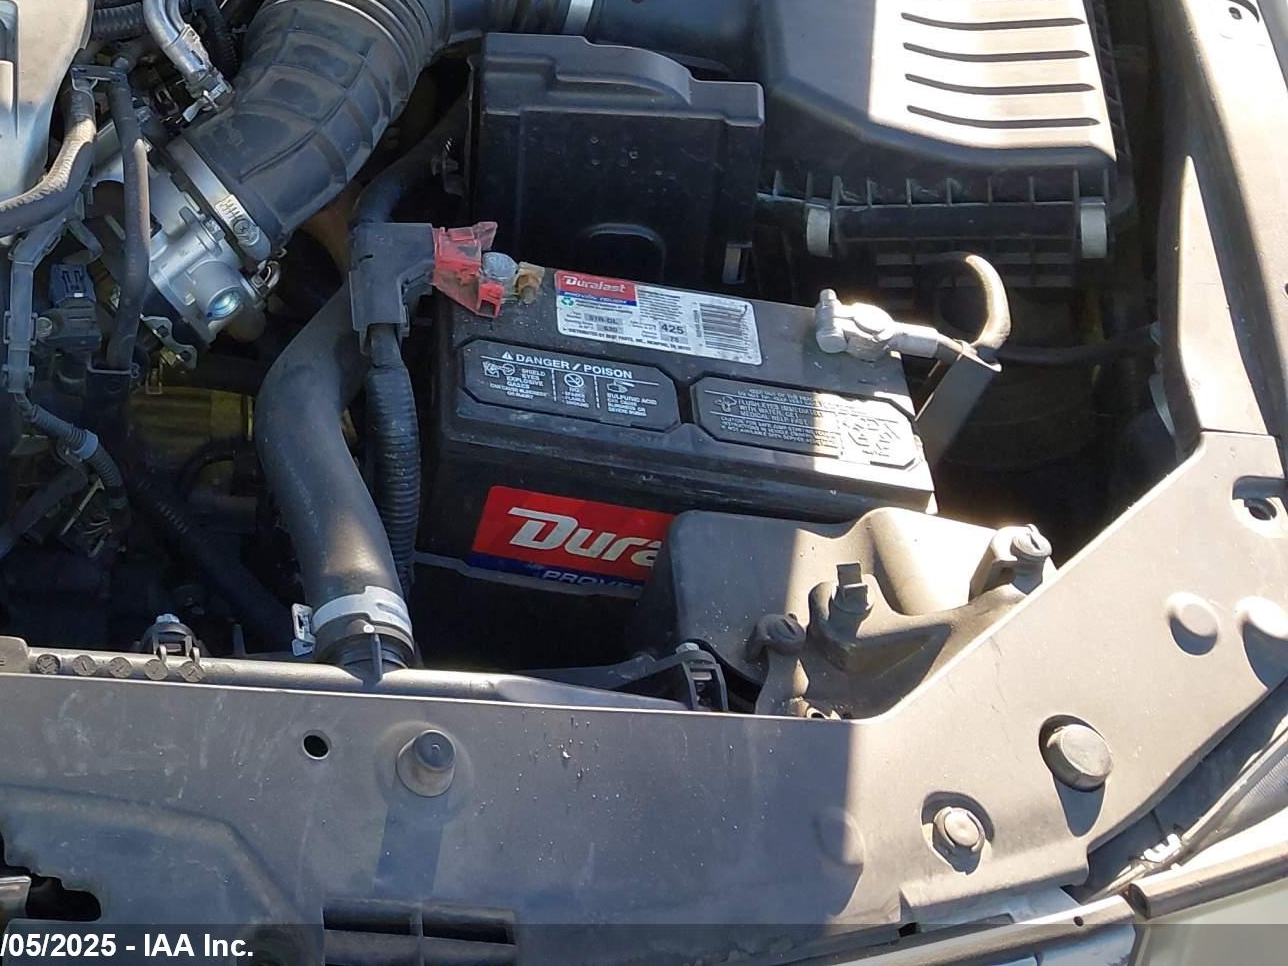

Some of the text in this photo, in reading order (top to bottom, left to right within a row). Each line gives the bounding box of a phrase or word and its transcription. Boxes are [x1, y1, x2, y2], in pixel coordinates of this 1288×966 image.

[562, 275, 626, 293] Duralast
[661, 323, 685, 335] 425
[516, 354, 570, 370] DANGER
[583, 364, 633, 379] POISON
[506, 375, 544, 386] EXPLOSIVE
